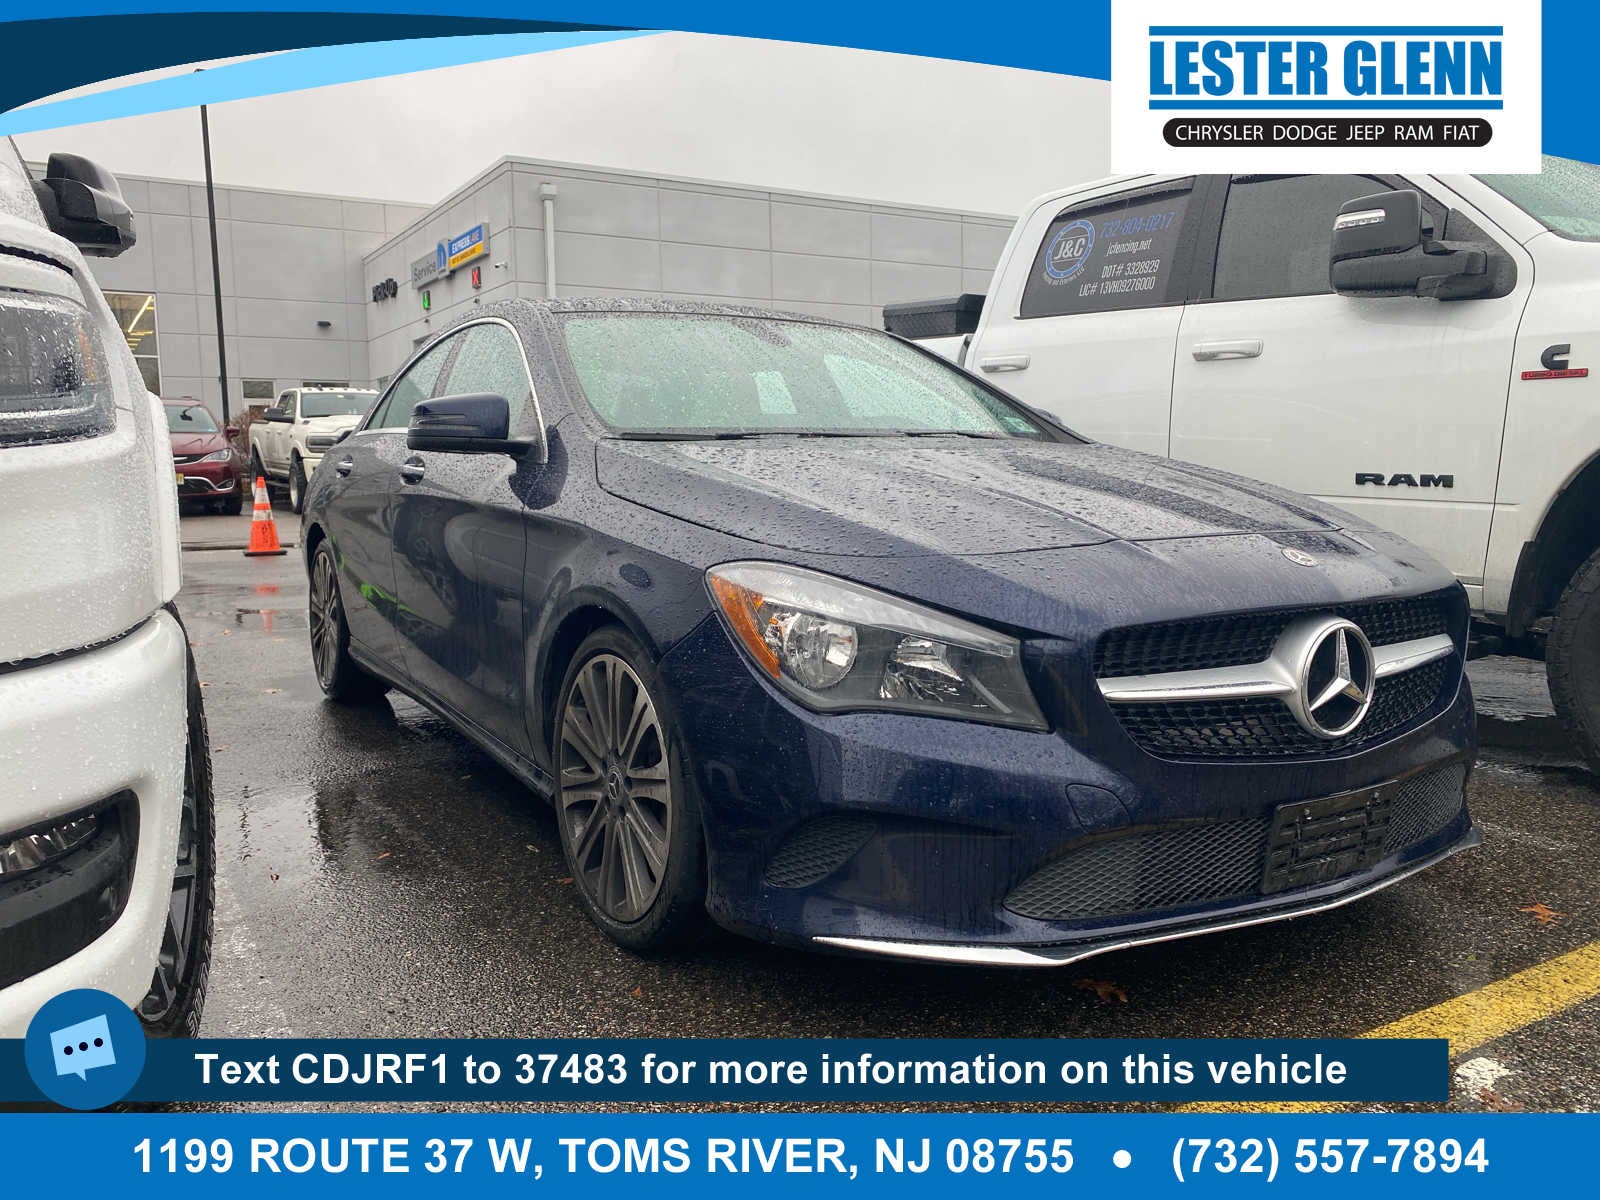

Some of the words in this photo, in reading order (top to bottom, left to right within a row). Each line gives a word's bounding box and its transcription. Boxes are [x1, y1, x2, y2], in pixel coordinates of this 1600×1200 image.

[1054, 238, 1085, 260] J&C
[1106, 238, 1153, 257] jcfencing.net
[1101, 264, 1124, 279] DOT#
[1079, 282, 1098, 297] LIC#
[1355, 472, 1454, 488] RAM
